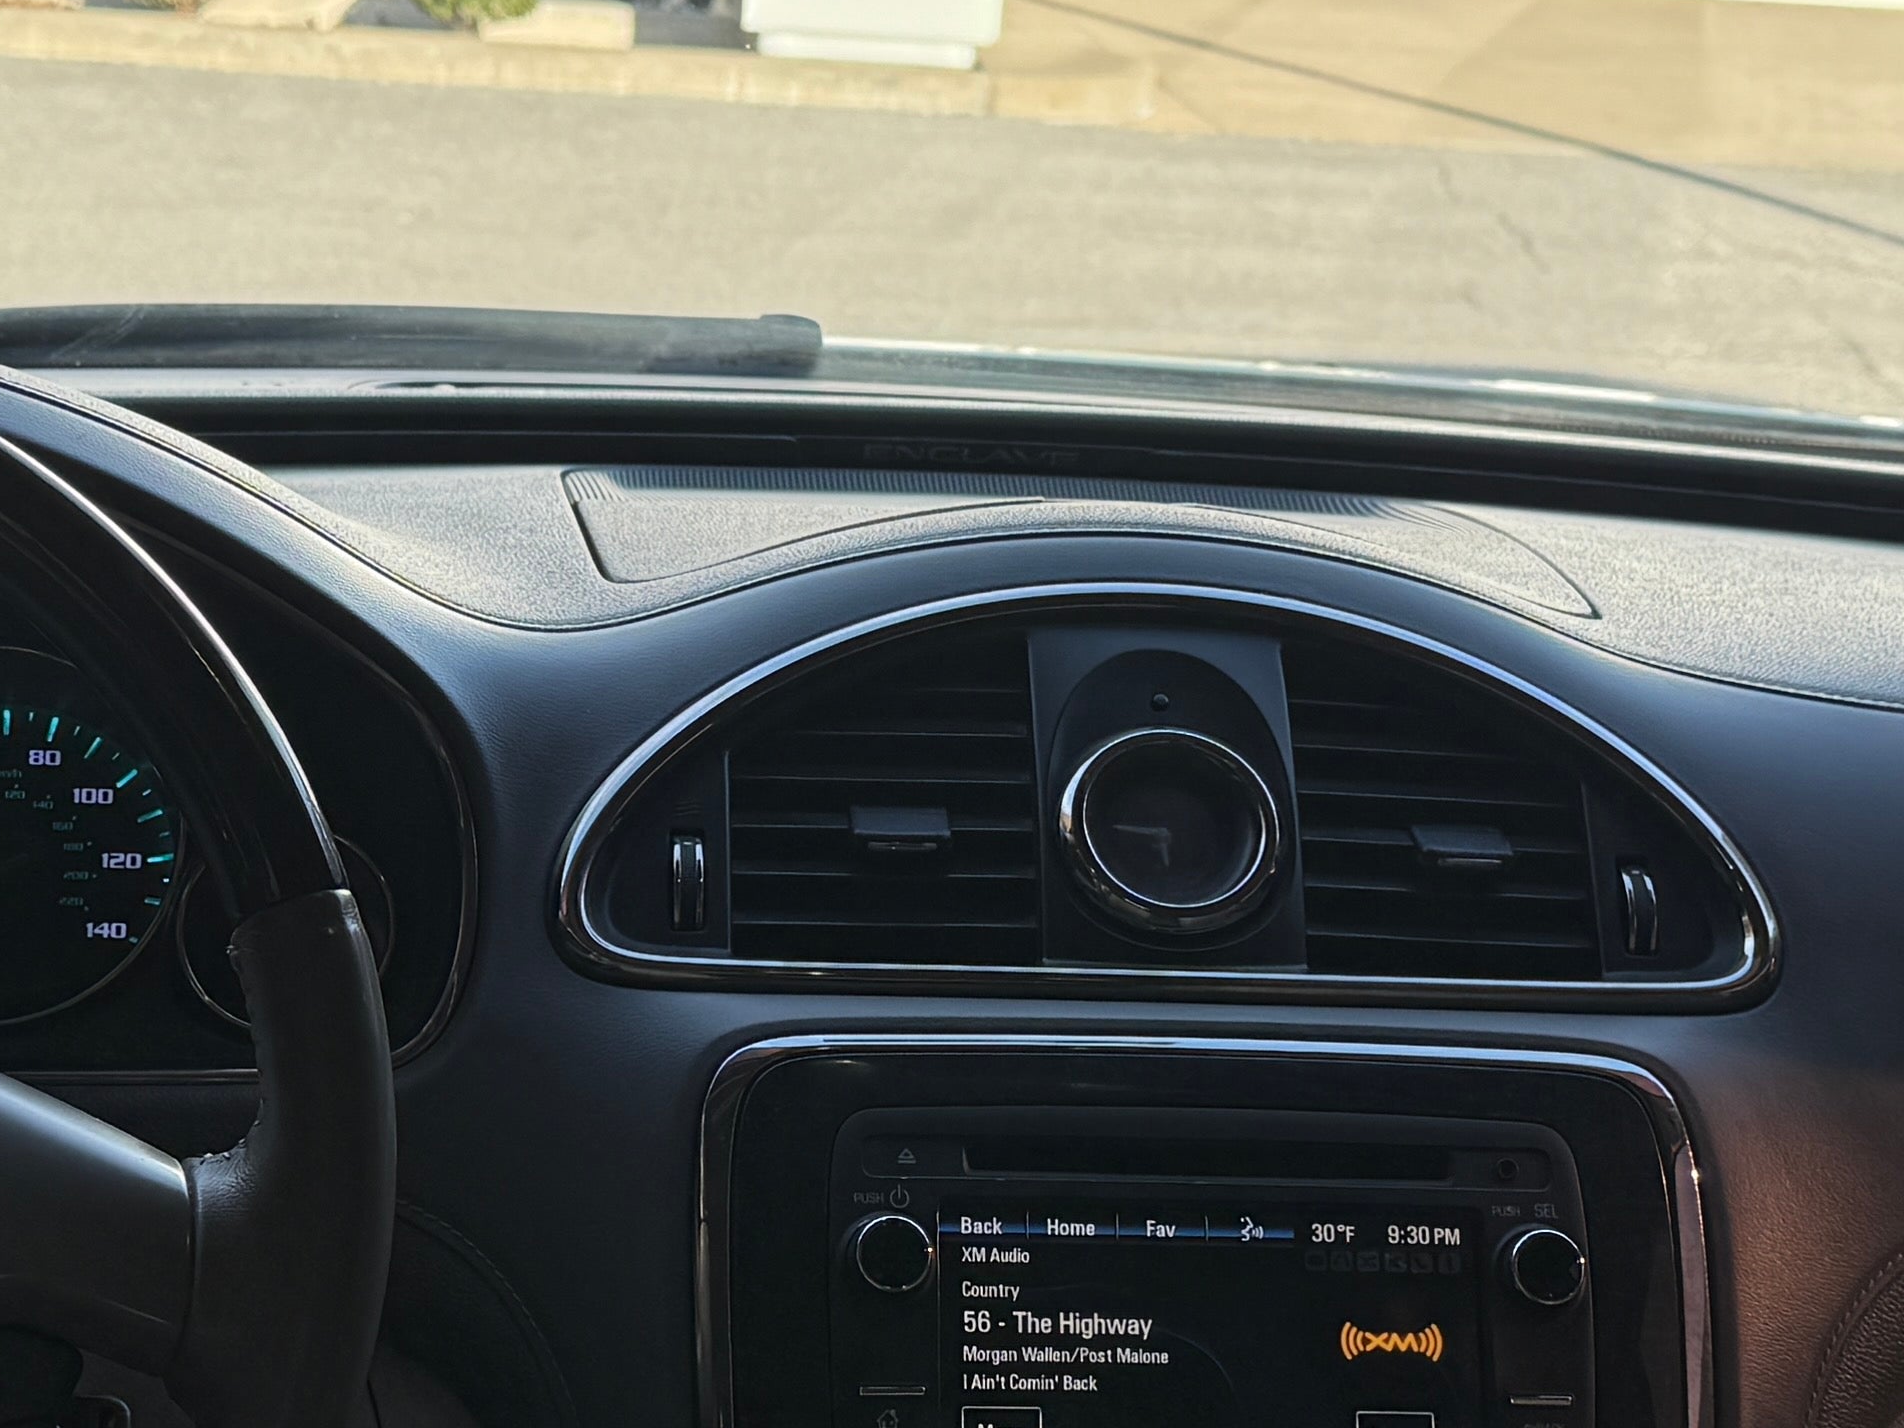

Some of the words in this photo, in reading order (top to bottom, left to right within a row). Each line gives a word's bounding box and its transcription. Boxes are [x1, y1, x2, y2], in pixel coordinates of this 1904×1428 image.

[27, 748, 63, 767] 80
[71, 786, 115, 805] 100
[100, 851, 144, 870] 120
[85, 921, 129, 940] 140
[959, 1217, 1003, 1235] Back
[1046, 1218, 1096, 1237] Home
[1145, 1219, 1177, 1238] Fav
[1311, 1223, 1356, 1243] 30°F
[1387, 1225, 1431, 1245] 9:30
[1434, 1227, 1461, 1246] PM
[961, 1247, 987, 1263] XM
[989, 1247, 1030, 1264] Audio
[961, 1280, 1020, 1302] Country
[963, 1310, 991, 1334] 56
[1012, 1310, 1053, 1334] The
[1059, 1312, 1153, 1340] Highway
[963, 1345, 1018, 1366] Morgan
[1022, 1346, 1113, 1364] Wallen/Post
[1116, 1348, 1170, 1365] Malone
[971, 1374, 1006, 1391] Ain't
[1009, 1374, 1059, 1391] Comin'
[1063, 1375, 1098, 1391] Back
